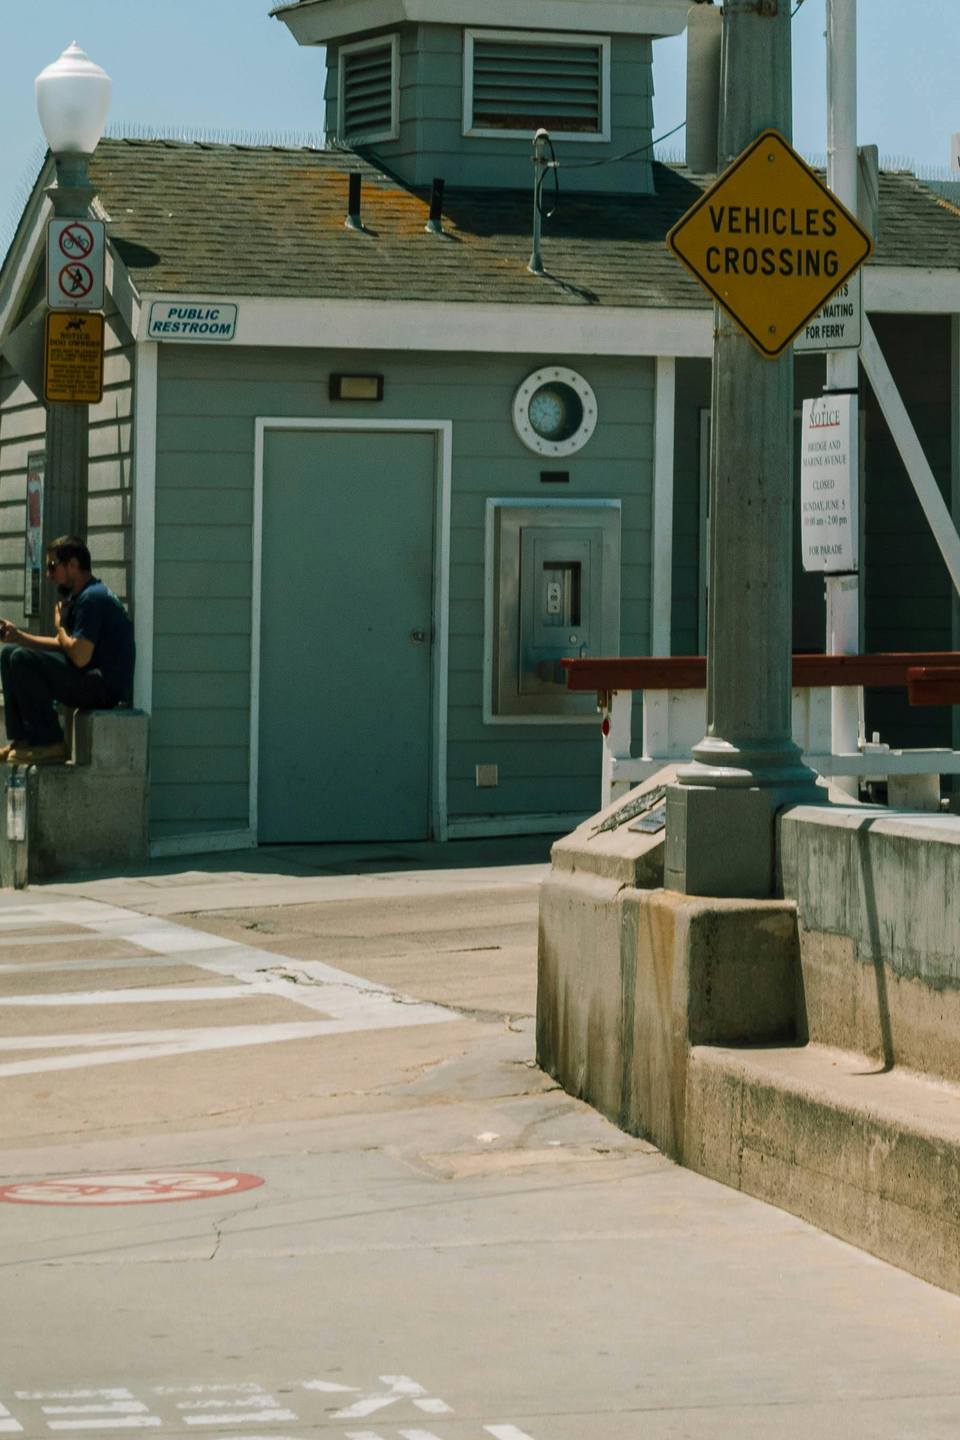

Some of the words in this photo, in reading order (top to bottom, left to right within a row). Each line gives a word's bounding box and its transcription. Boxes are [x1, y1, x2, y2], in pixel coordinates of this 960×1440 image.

[709, 206, 837, 236] VEHICLES
[706, 246, 839, 277] CROSSING
[168, 308, 220, 320] PUBLIC
[823, 303, 854, 318] WAITING
[152, 321, 231, 335] RESTROOM
[806, 325, 820, 339] FOR
[821, 323, 845, 338] FERRY
[809, 410, 840, 427] NOTICE
[829, 440, 841, 451] AND
[824, 454, 847, 466] AVENUE
[813, 479, 835, 491] CLOSED
[825, 500, 841, 511] JUNE
[820, 544, 843, 556] PARADE
